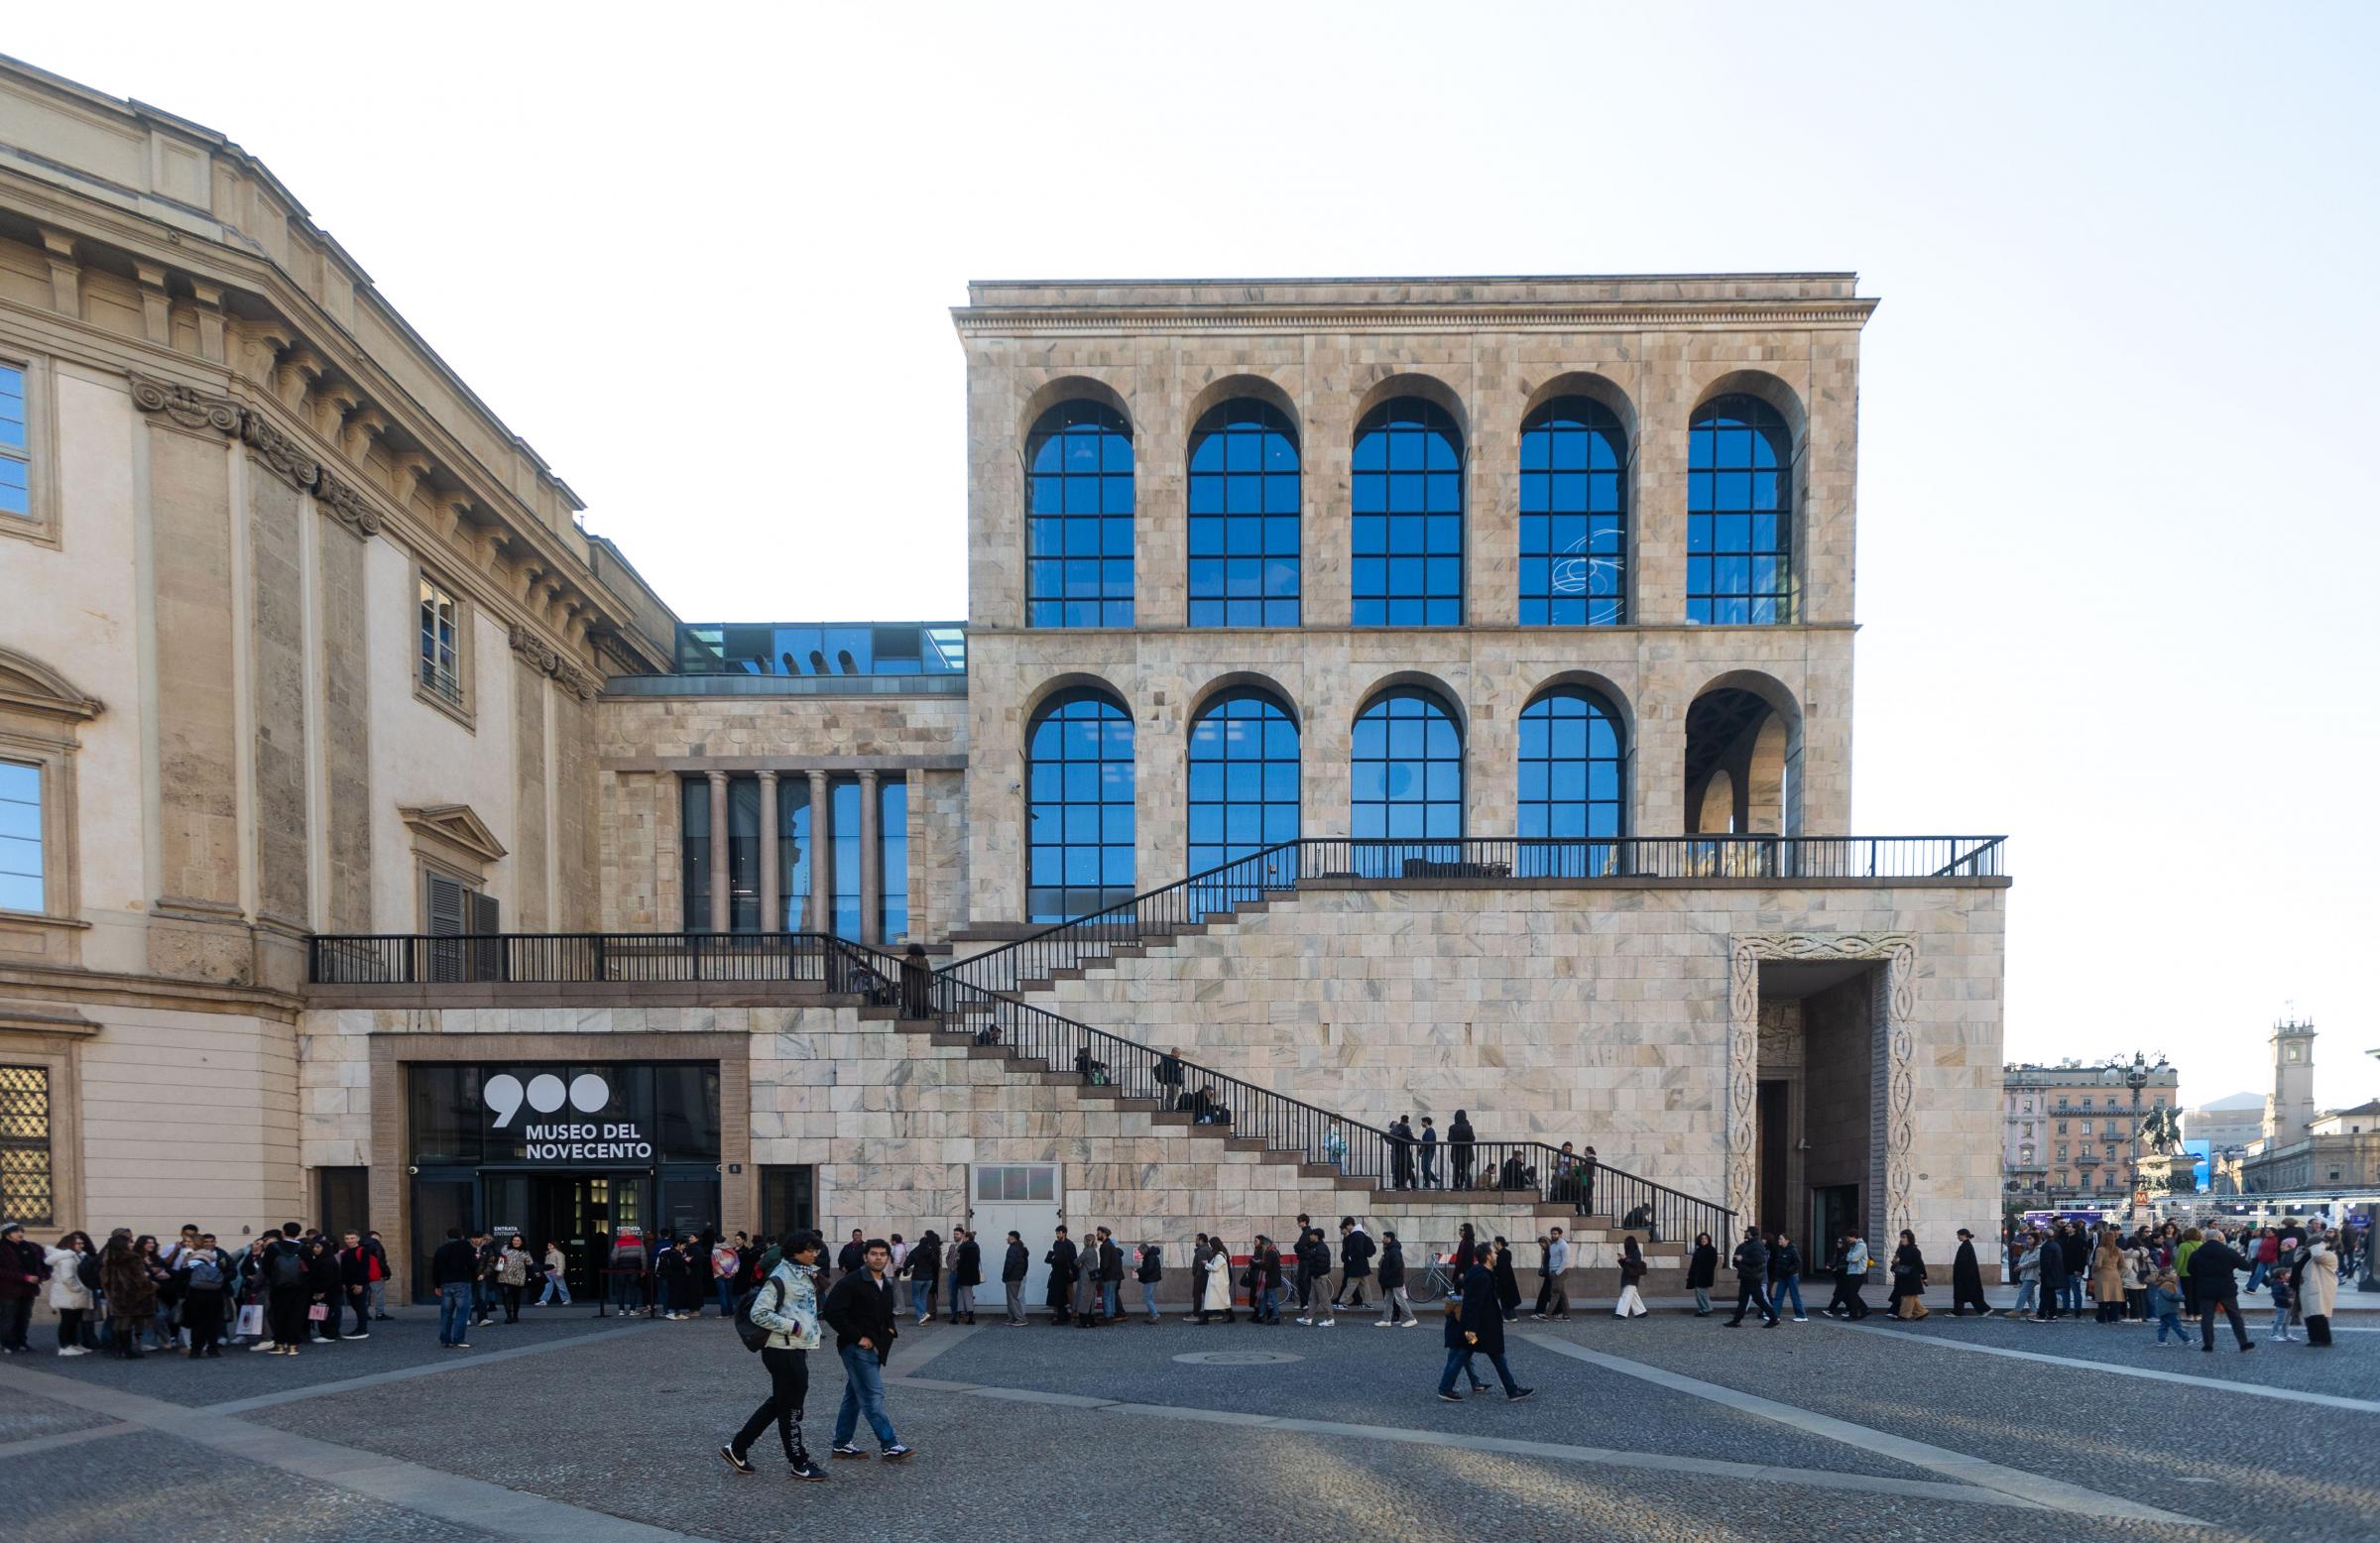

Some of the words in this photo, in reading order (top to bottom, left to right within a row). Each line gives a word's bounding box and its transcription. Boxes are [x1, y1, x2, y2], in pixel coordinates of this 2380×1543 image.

[483, 1073, 610, 1128] 900
[526, 1124, 597, 1140] MUSEO
[603, 1124, 641, 1139] DEL
[526, 1142, 652, 1159] NOVECENTO
[2136, 1193, 2147, 1203] M
